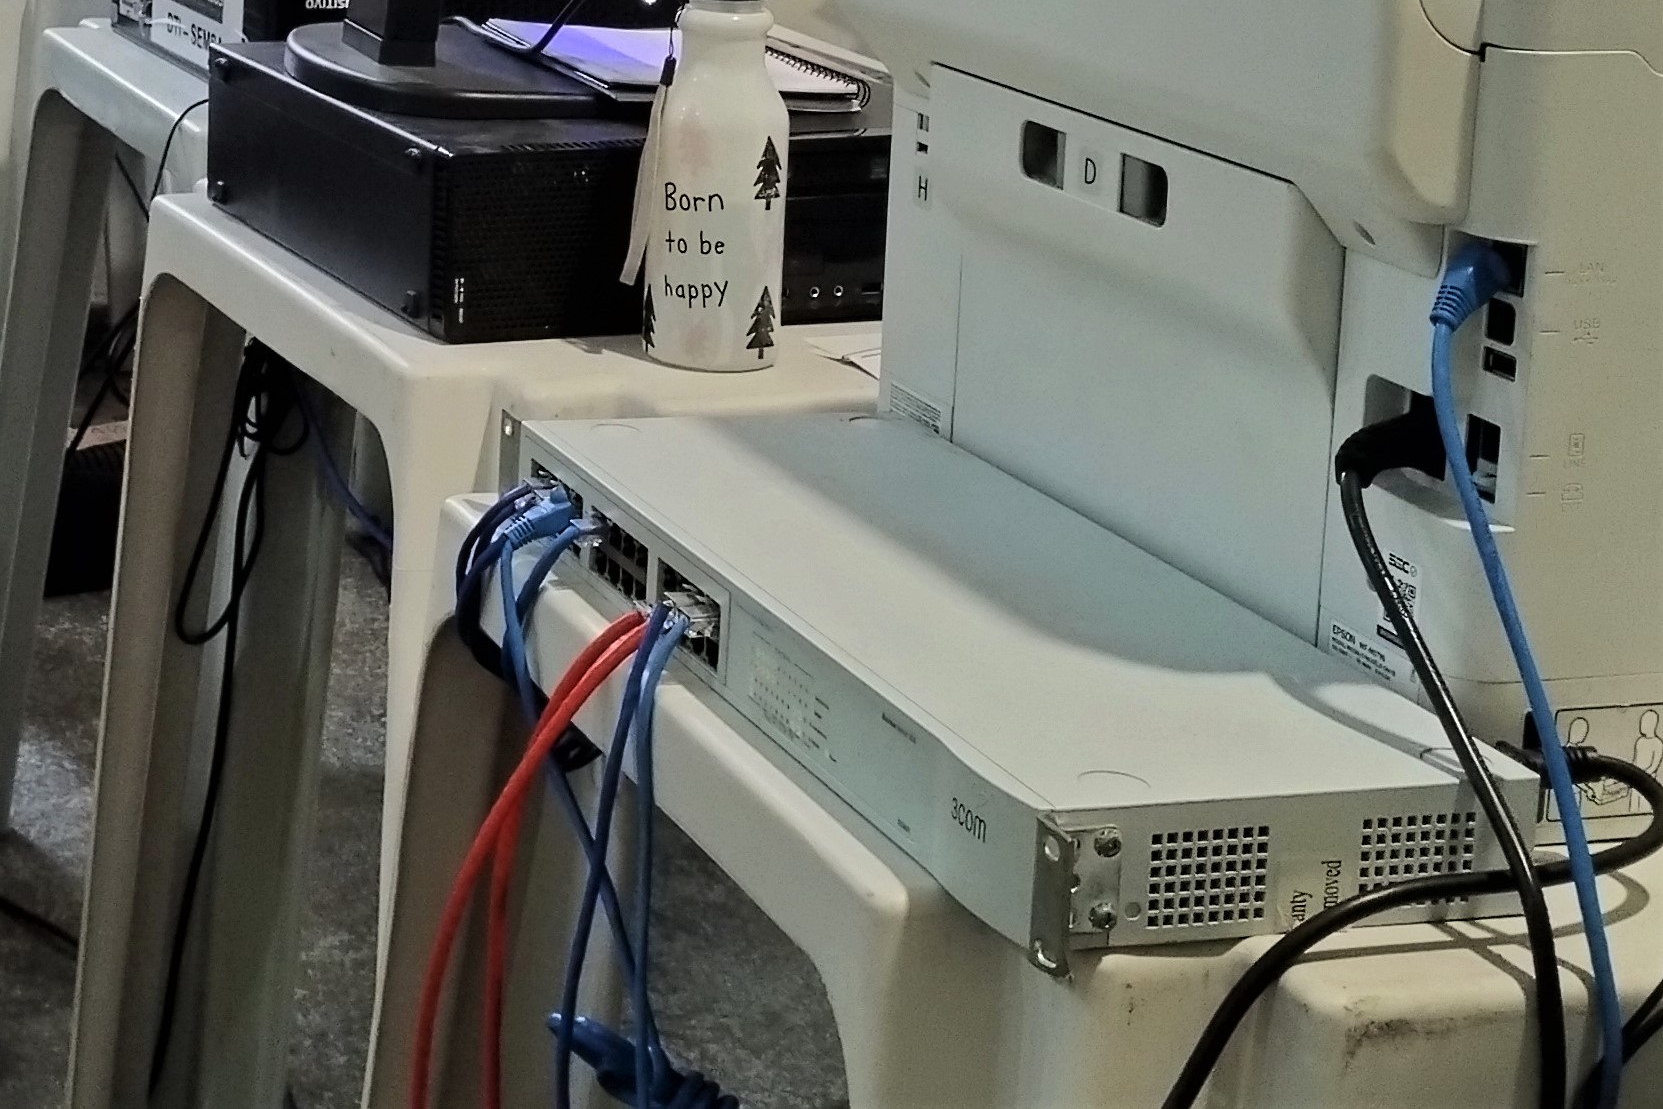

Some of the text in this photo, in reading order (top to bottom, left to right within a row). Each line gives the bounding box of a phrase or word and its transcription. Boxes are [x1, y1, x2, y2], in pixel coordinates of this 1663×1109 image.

[1084, 157, 1097, 185] D
[664, 181, 725, 213] Born
[917, 174, 929, 202] H
[665, 229, 726, 255] to be
[664, 274, 729, 309] happy
[1573, 318, 1601, 330] USB
[1332, 624, 1356, 644] EPSON
